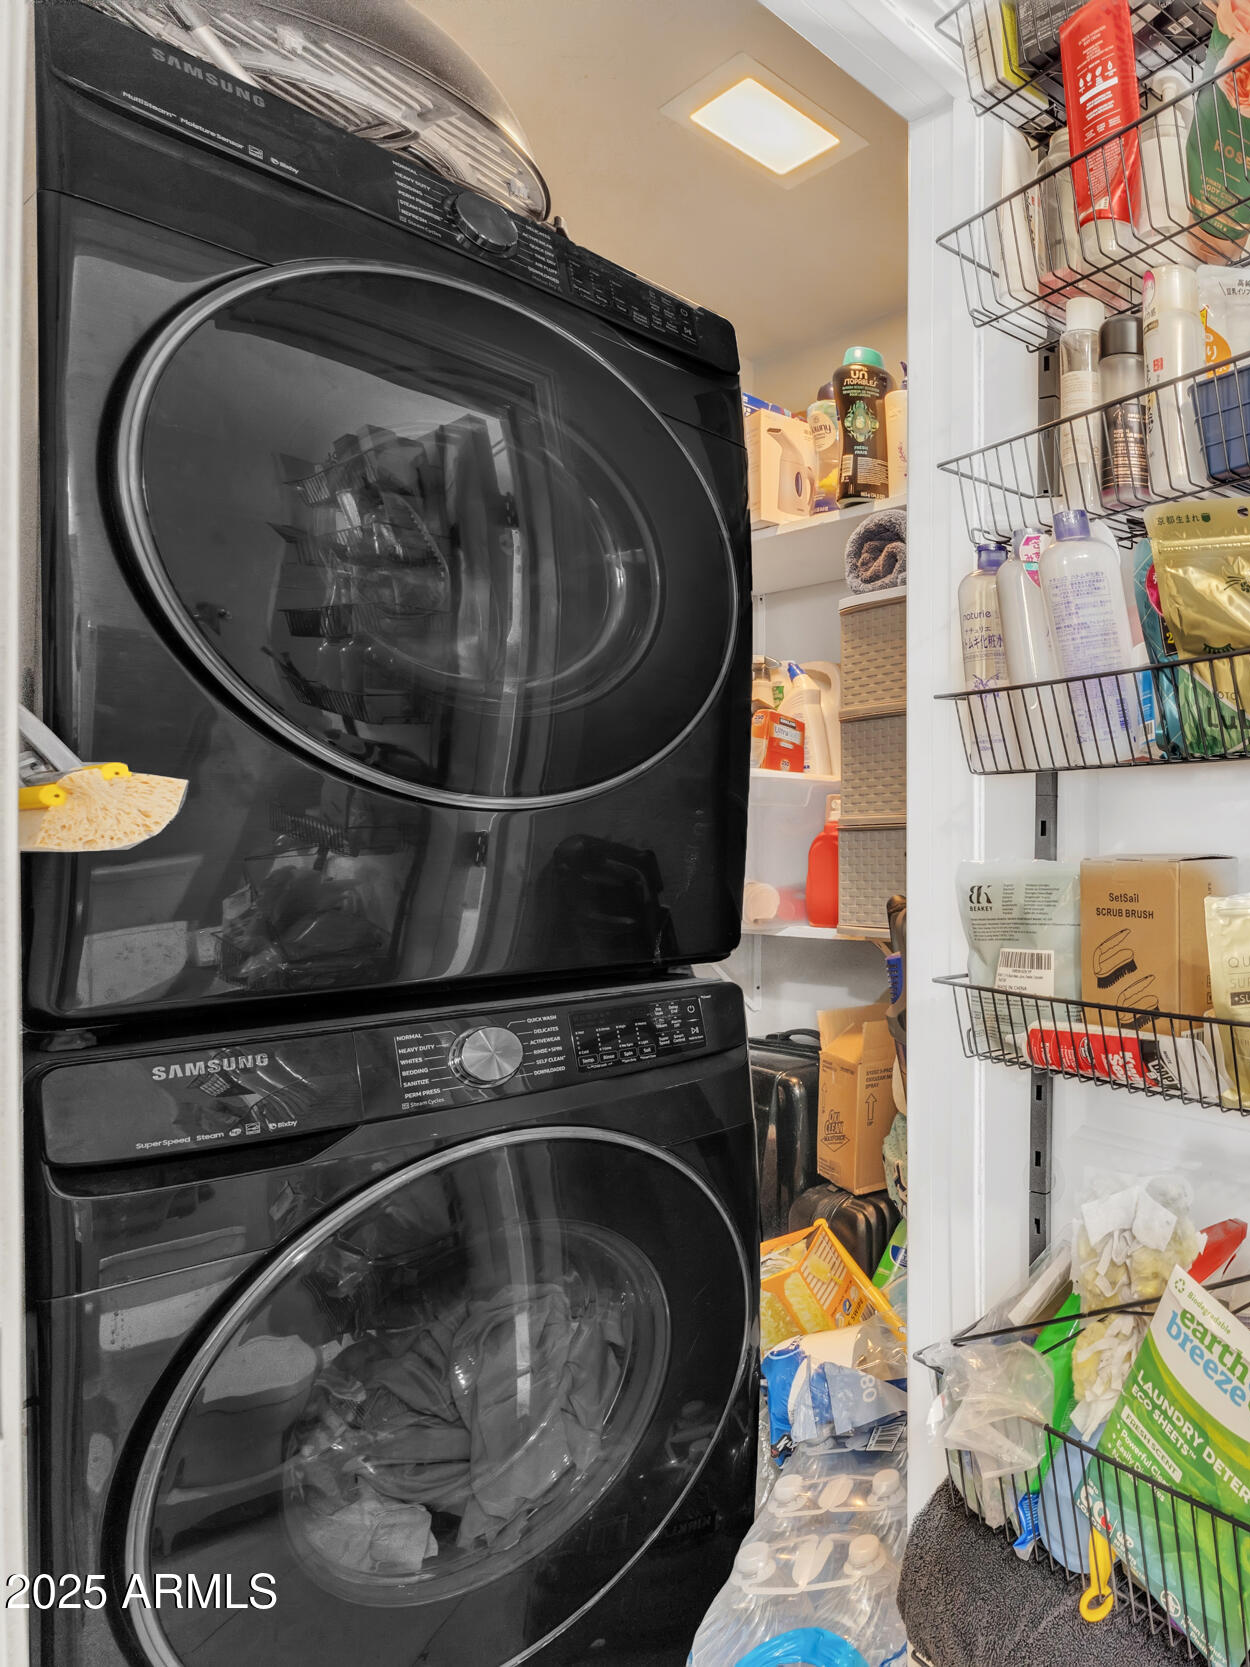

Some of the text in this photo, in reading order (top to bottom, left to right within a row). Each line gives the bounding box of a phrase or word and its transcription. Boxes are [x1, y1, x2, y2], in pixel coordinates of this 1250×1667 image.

[152, 47, 265, 108] SAMSUNG
[1157, 514, 1200, 526] 京都生まれ
[1108, 892, 1139, 903] SetSail
[1096, 907, 1154, 919] SCRUB BRUSH
[526, 1014, 557, 1024] QUICK WASH
[533, 1026, 559, 1034] DELICATES
[396, 1033, 422, 1041] NORMAL
[399, 1044, 435, 1054] HEAVY DUTY
[152, 1053, 269, 1080] SAMSUNG
[400, 1057, 423, 1065] WHITES
[401, 1068, 429, 1076] BEDDING
[1152, 1063, 1175, 1083] DAP
[403, 1079, 430, 1088] SANITIZE
[405, 1088, 441, 1099] PERM PRESS
[410, 1100, 427, 1108] Steam
[196, 1132, 224, 1141] Steam
[1187, 1291, 1231, 1335] Biodegradable
[1180, 1308, 1249, 1385] earth
[1166, 1309, 1246, 1407] breeze
[1131, 1384, 1153, 1411] ECO
[1137, 1369, 1205, 1447] LAUNDRY
[1120, 1429, 1152, 1468] Powerful
[1125, 1413, 1150, 1441] FRESH
[1150, 1440, 1177, 1474] SCENT
[1117, 1440, 1134, 1465] Easily
